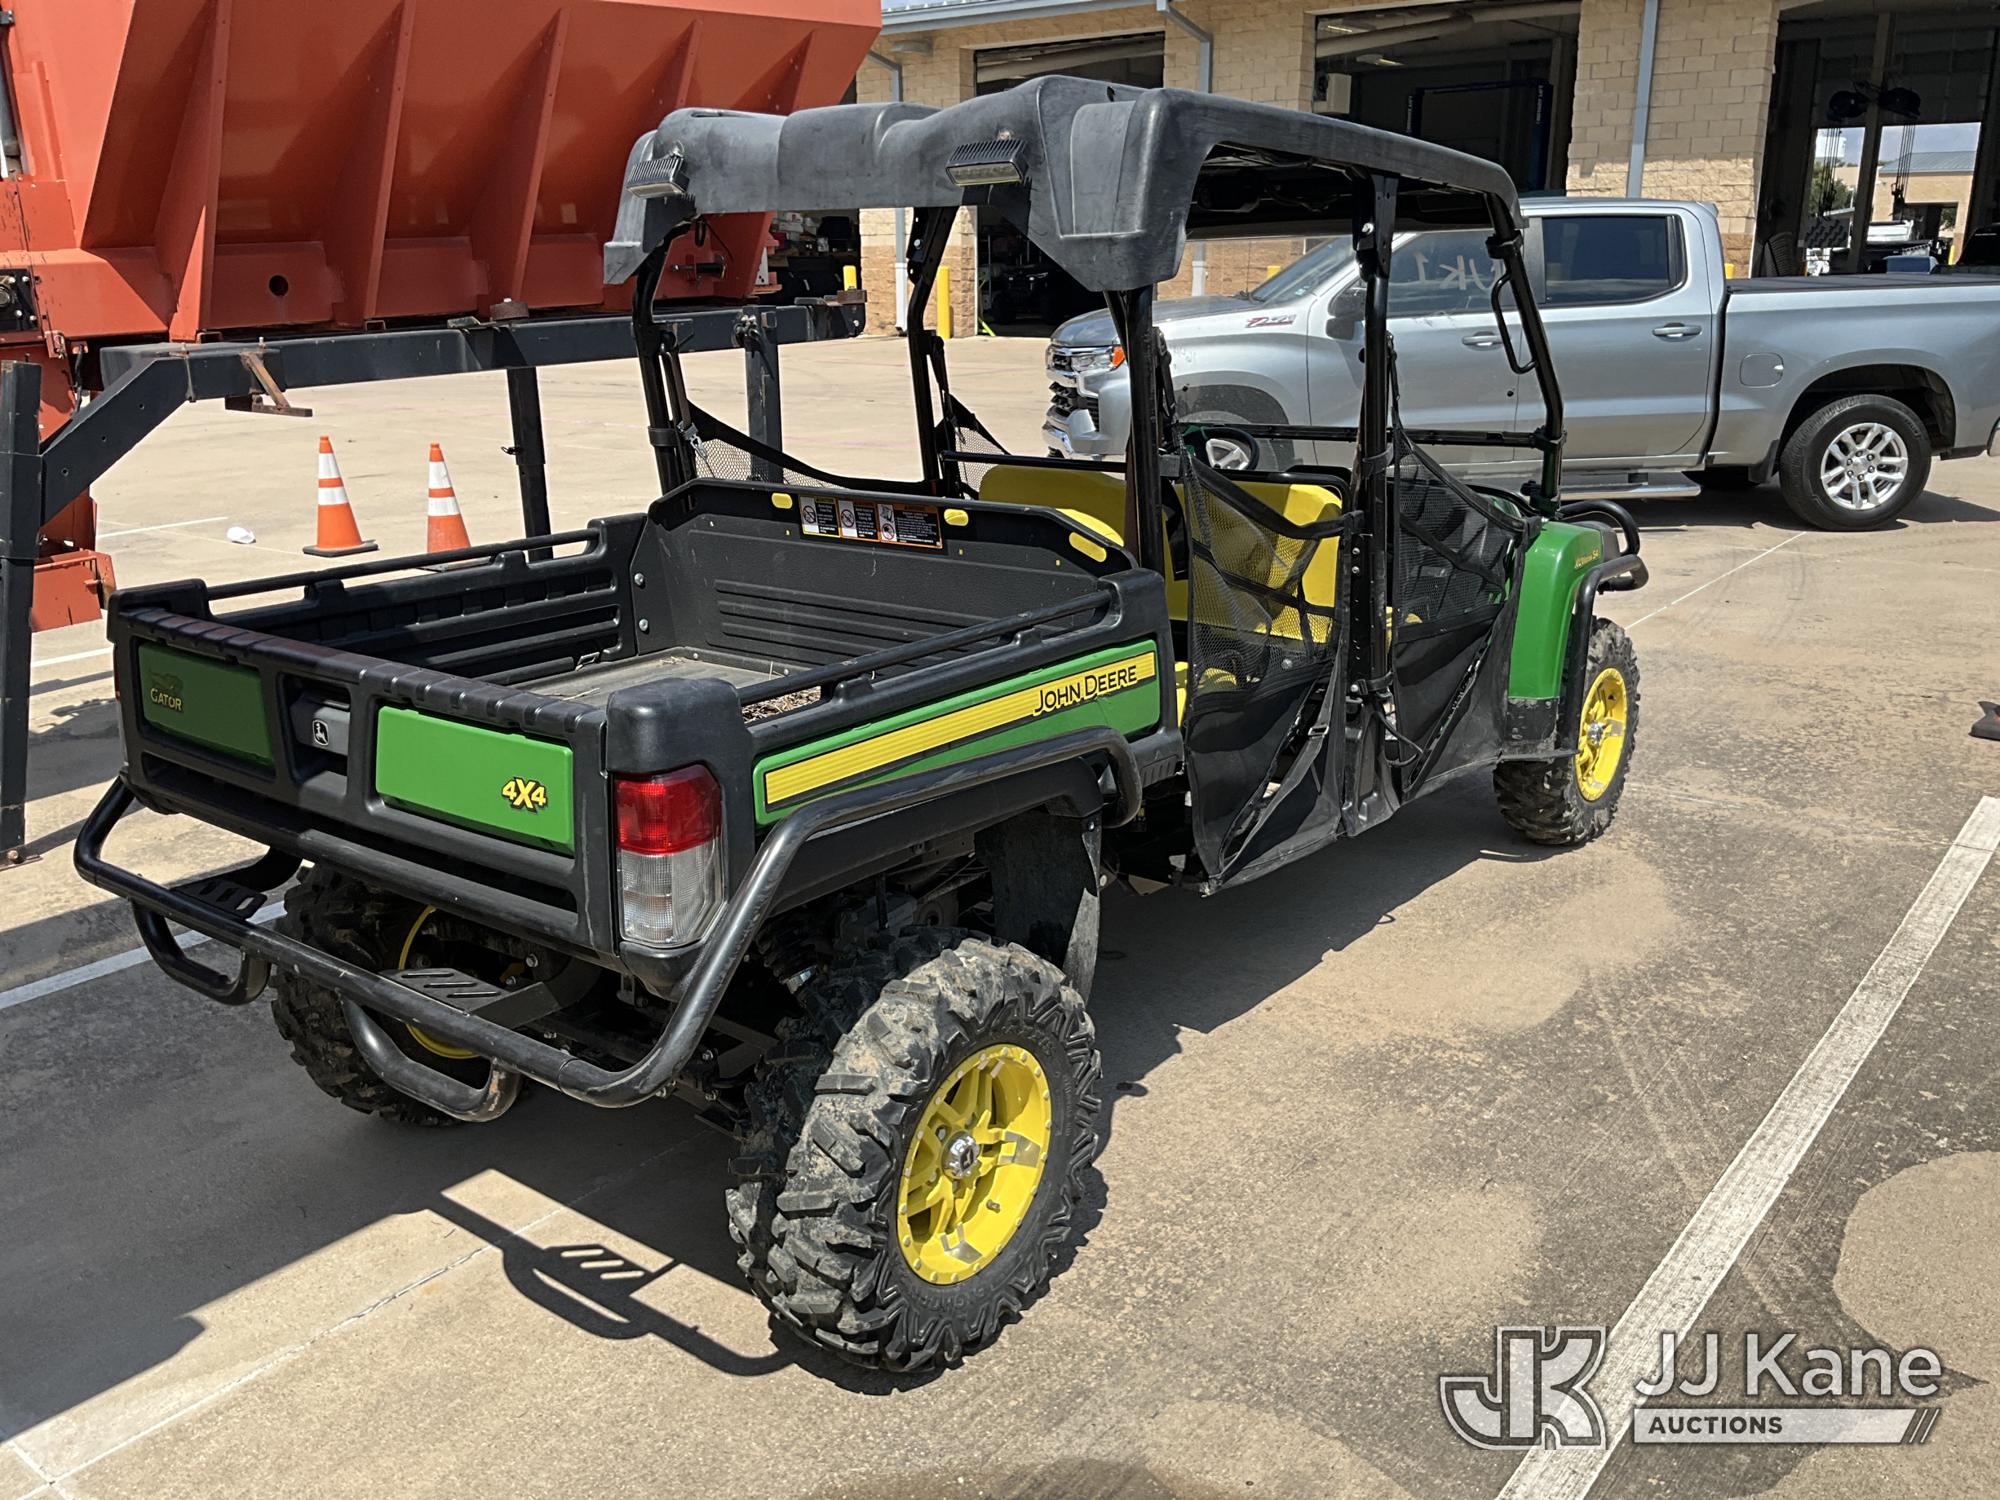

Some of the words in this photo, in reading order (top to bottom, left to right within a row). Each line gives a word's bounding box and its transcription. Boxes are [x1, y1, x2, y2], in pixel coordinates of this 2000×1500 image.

[150, 687, 182, 711] GATOR
[1034, 682, 1081, 713] JOHN
[1084, 665, 1138, 697] DEERE
[502, 778, 547, 810] 4X4
